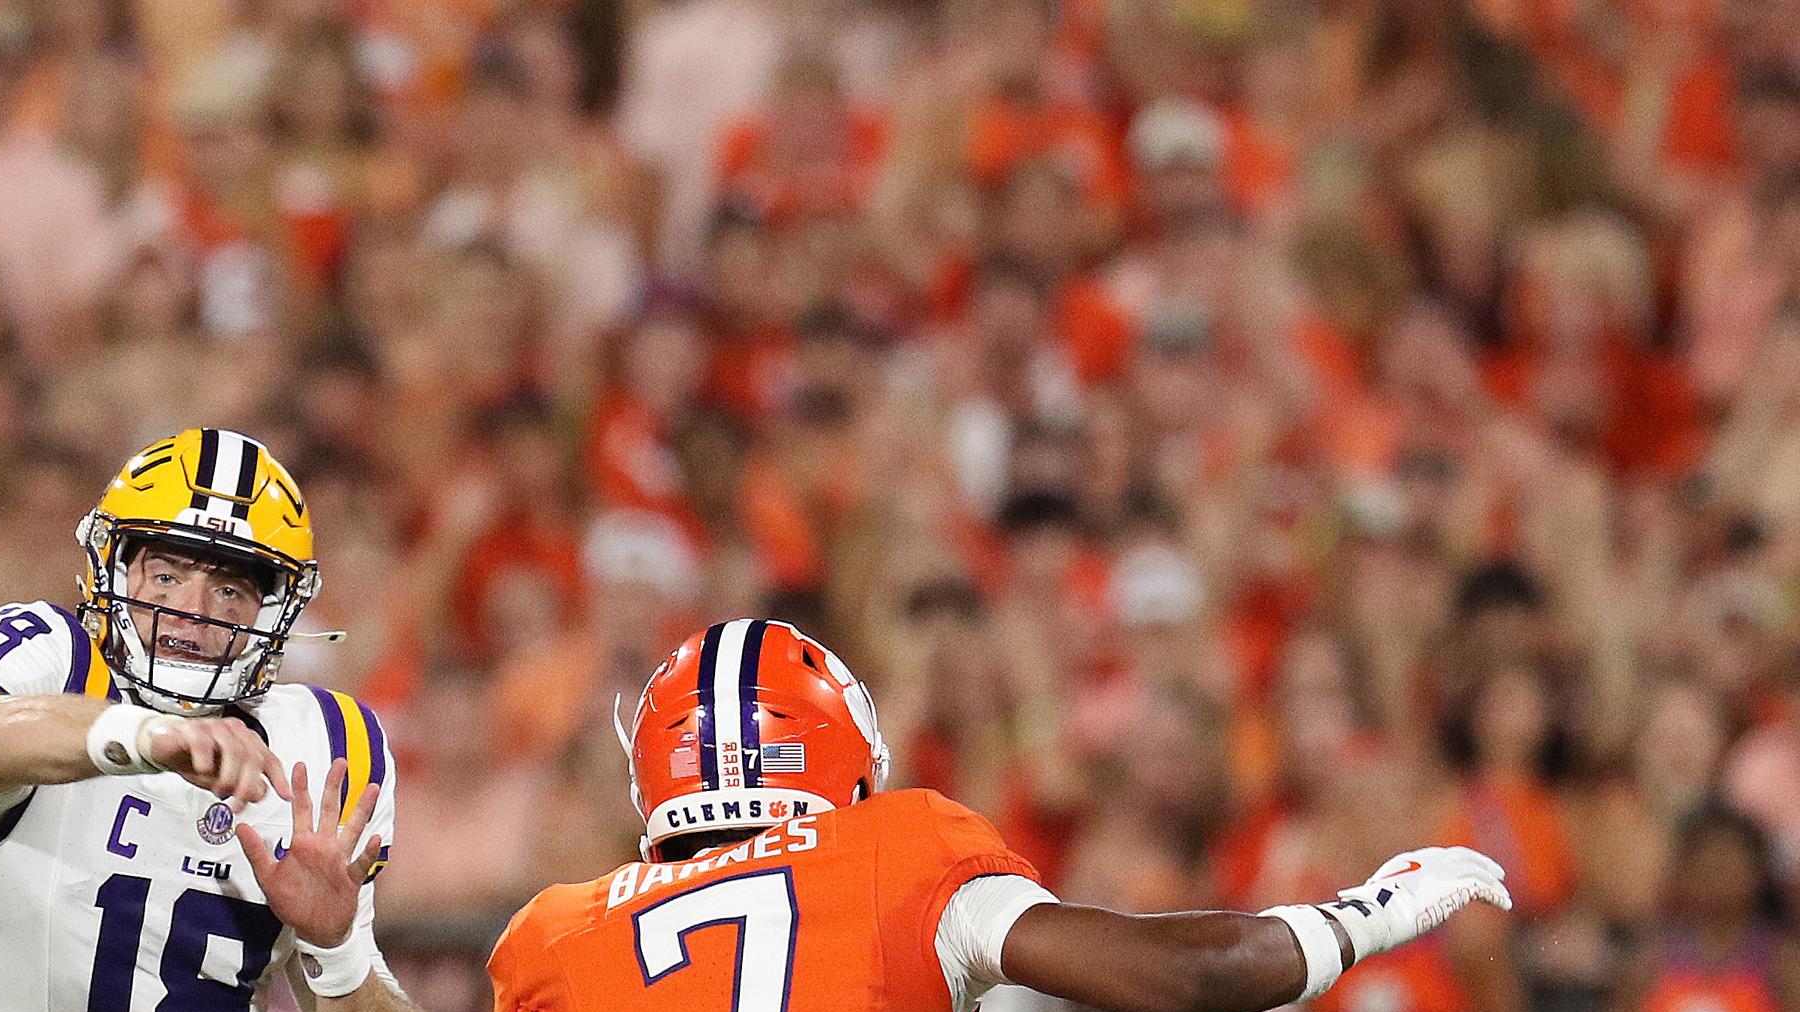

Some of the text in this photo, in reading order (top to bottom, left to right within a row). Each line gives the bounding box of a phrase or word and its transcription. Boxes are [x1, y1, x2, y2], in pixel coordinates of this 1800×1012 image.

[195, 513, 236, 533] LSU
[743, 748, 760, 770] 7
[666, 800, 809, 828] CLEMSN
[106, 794, 152, 860] C
[181, 855, 232, 880] LSU
